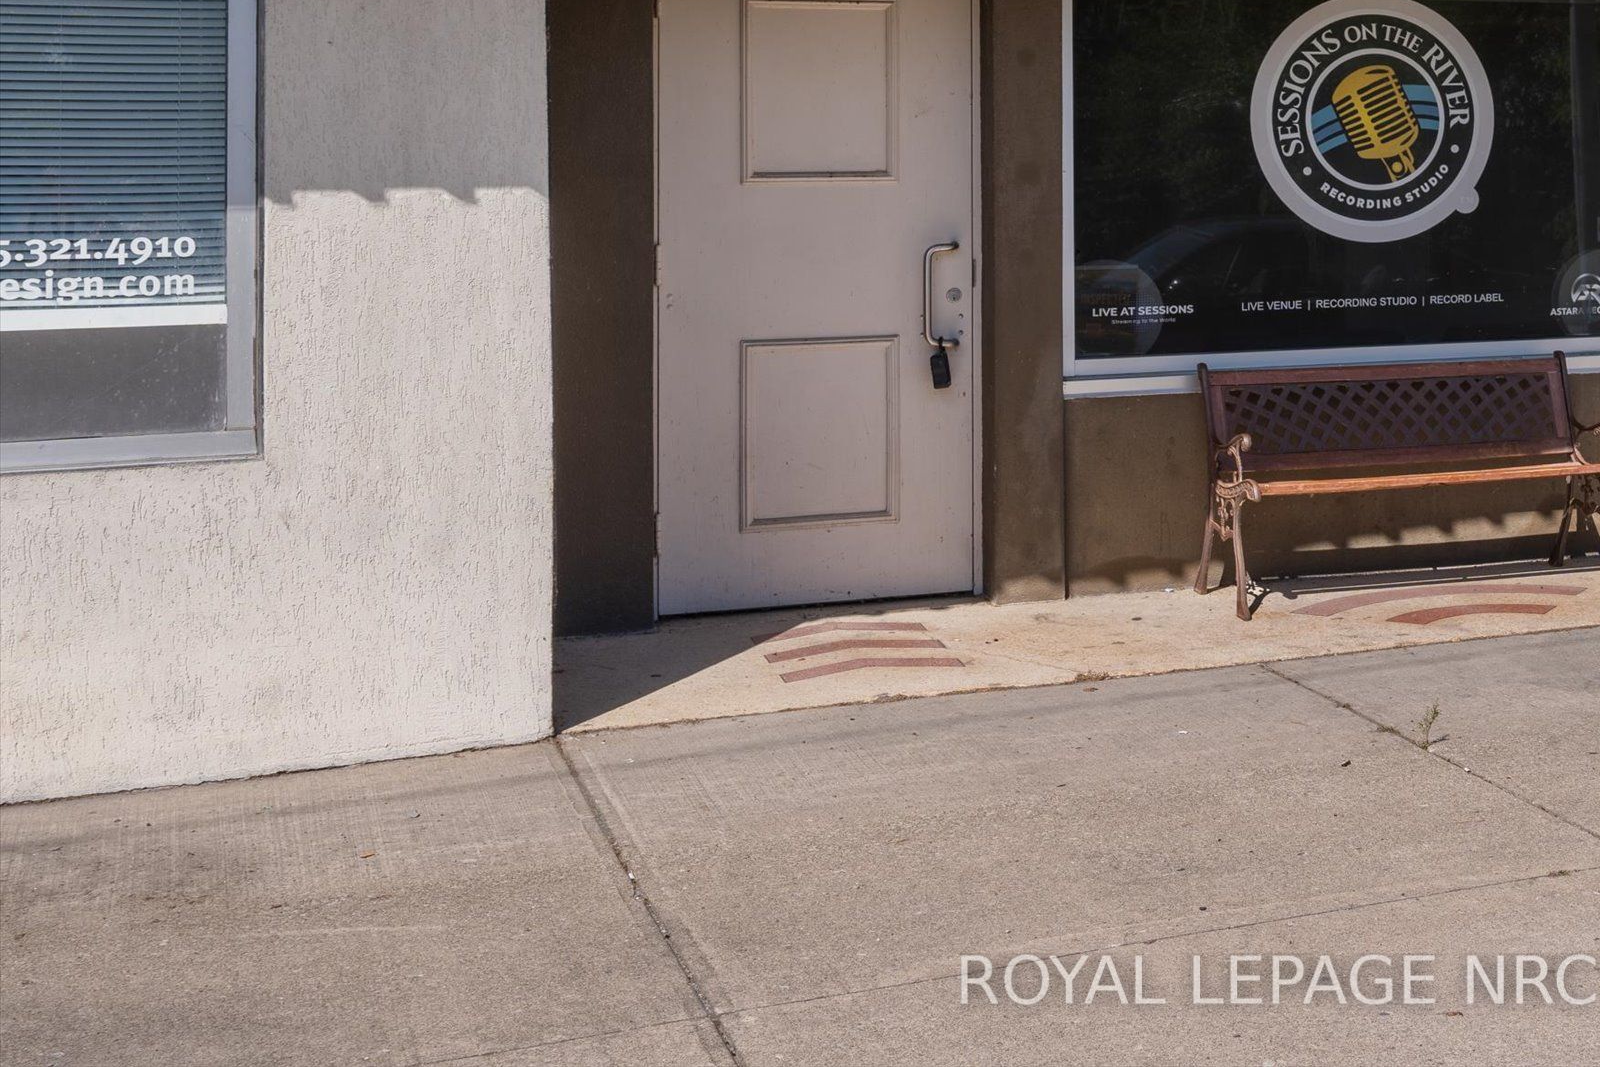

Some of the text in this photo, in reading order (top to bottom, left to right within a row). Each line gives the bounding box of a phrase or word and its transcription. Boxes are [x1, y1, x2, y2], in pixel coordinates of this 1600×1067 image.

[1276, 22, 1471, 158] SESSIONS ON THE RIVER
[1319, 163, 1450, 210] RECORDING STUDIO
[0, 235, 197, 268] 5.321.4910
[0, 269, 196, 304] esign.com
[1241, 301, 1265, 312] LIVE
[1266, 300, 1303, 311] VENUE
[1315, 297, 1378, 309] RECORDING
[1380, 296, 1418, 307] STUDIO
[1429, 294, 1472, 305] RECORD
[1474, 293, 1505, 303] LABEL
[1092, 304, 1195, 317] LIVE AT SESSIONS
